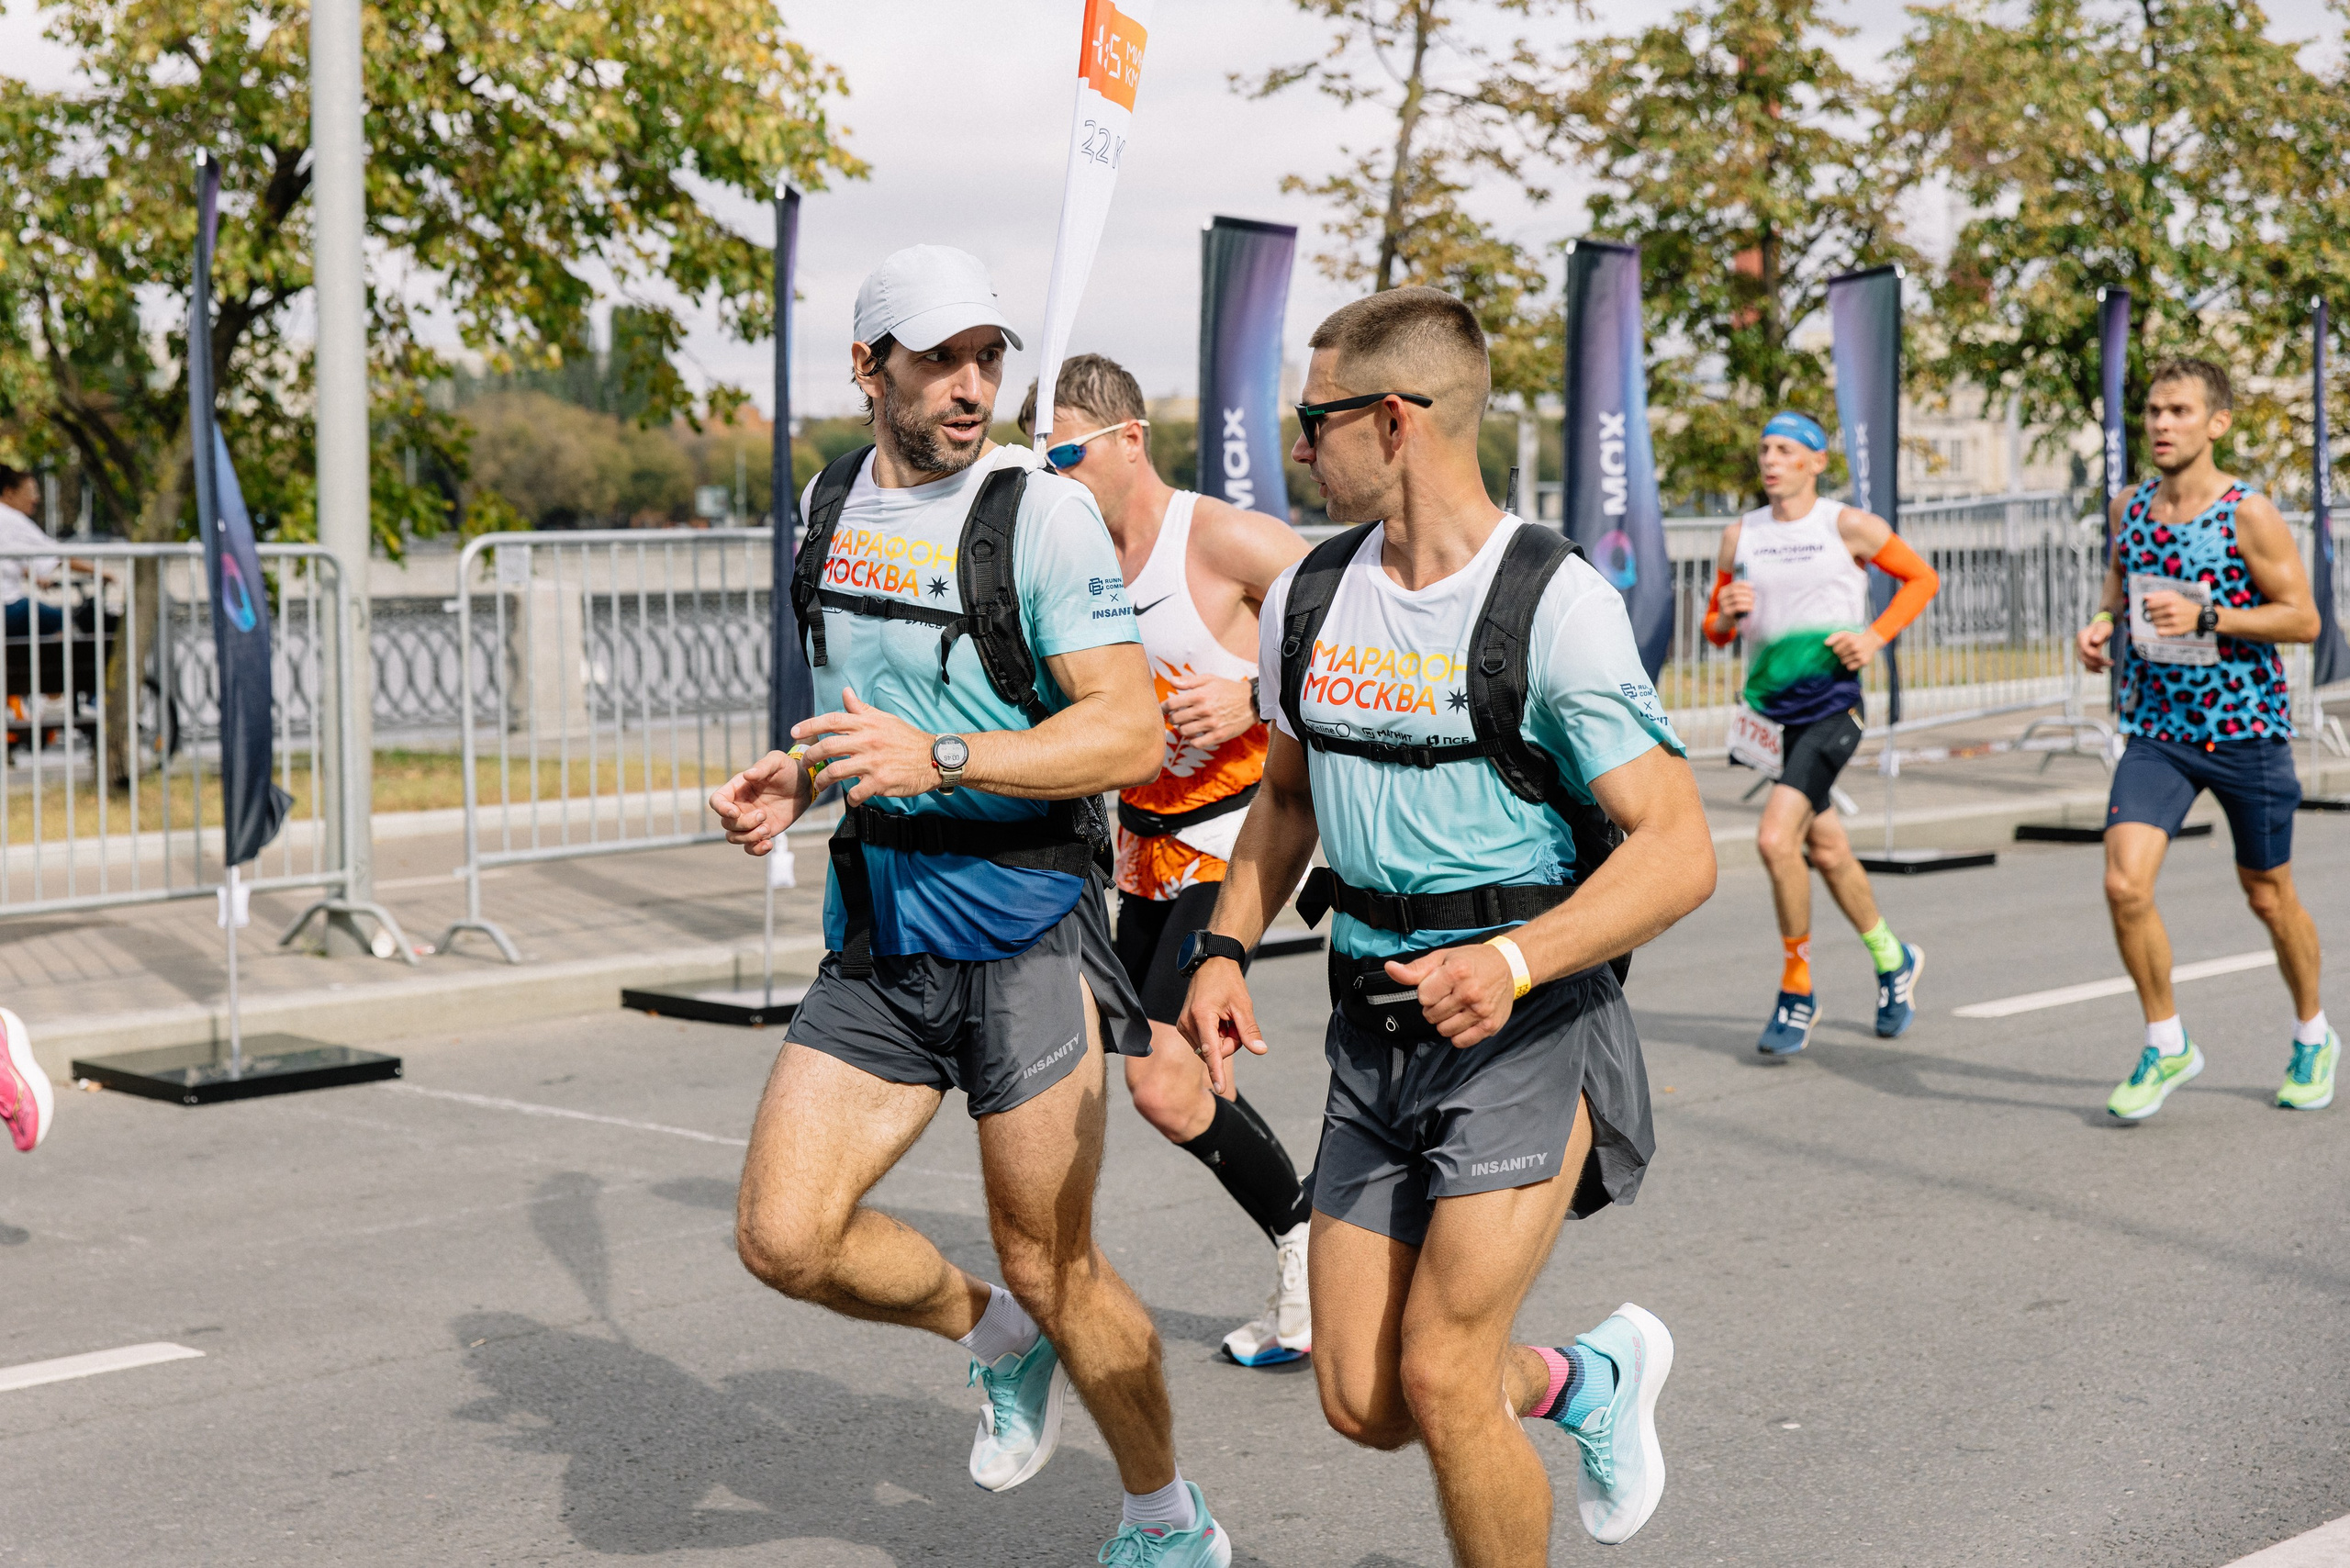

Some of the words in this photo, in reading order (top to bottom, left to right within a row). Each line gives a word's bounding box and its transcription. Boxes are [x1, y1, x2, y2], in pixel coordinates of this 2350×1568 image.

[1081, 120, 1111, 163] 22
[1303, 672, 1438, 716] МОСКВА
[1377, 728, 1413, 743] МАГНИТ
[1443, 736, 1471, 745] ПСБ
[1023, 1032, 1080, 1080] INSANITY
[1472, 1152, 1549, 1177] INSANITY
